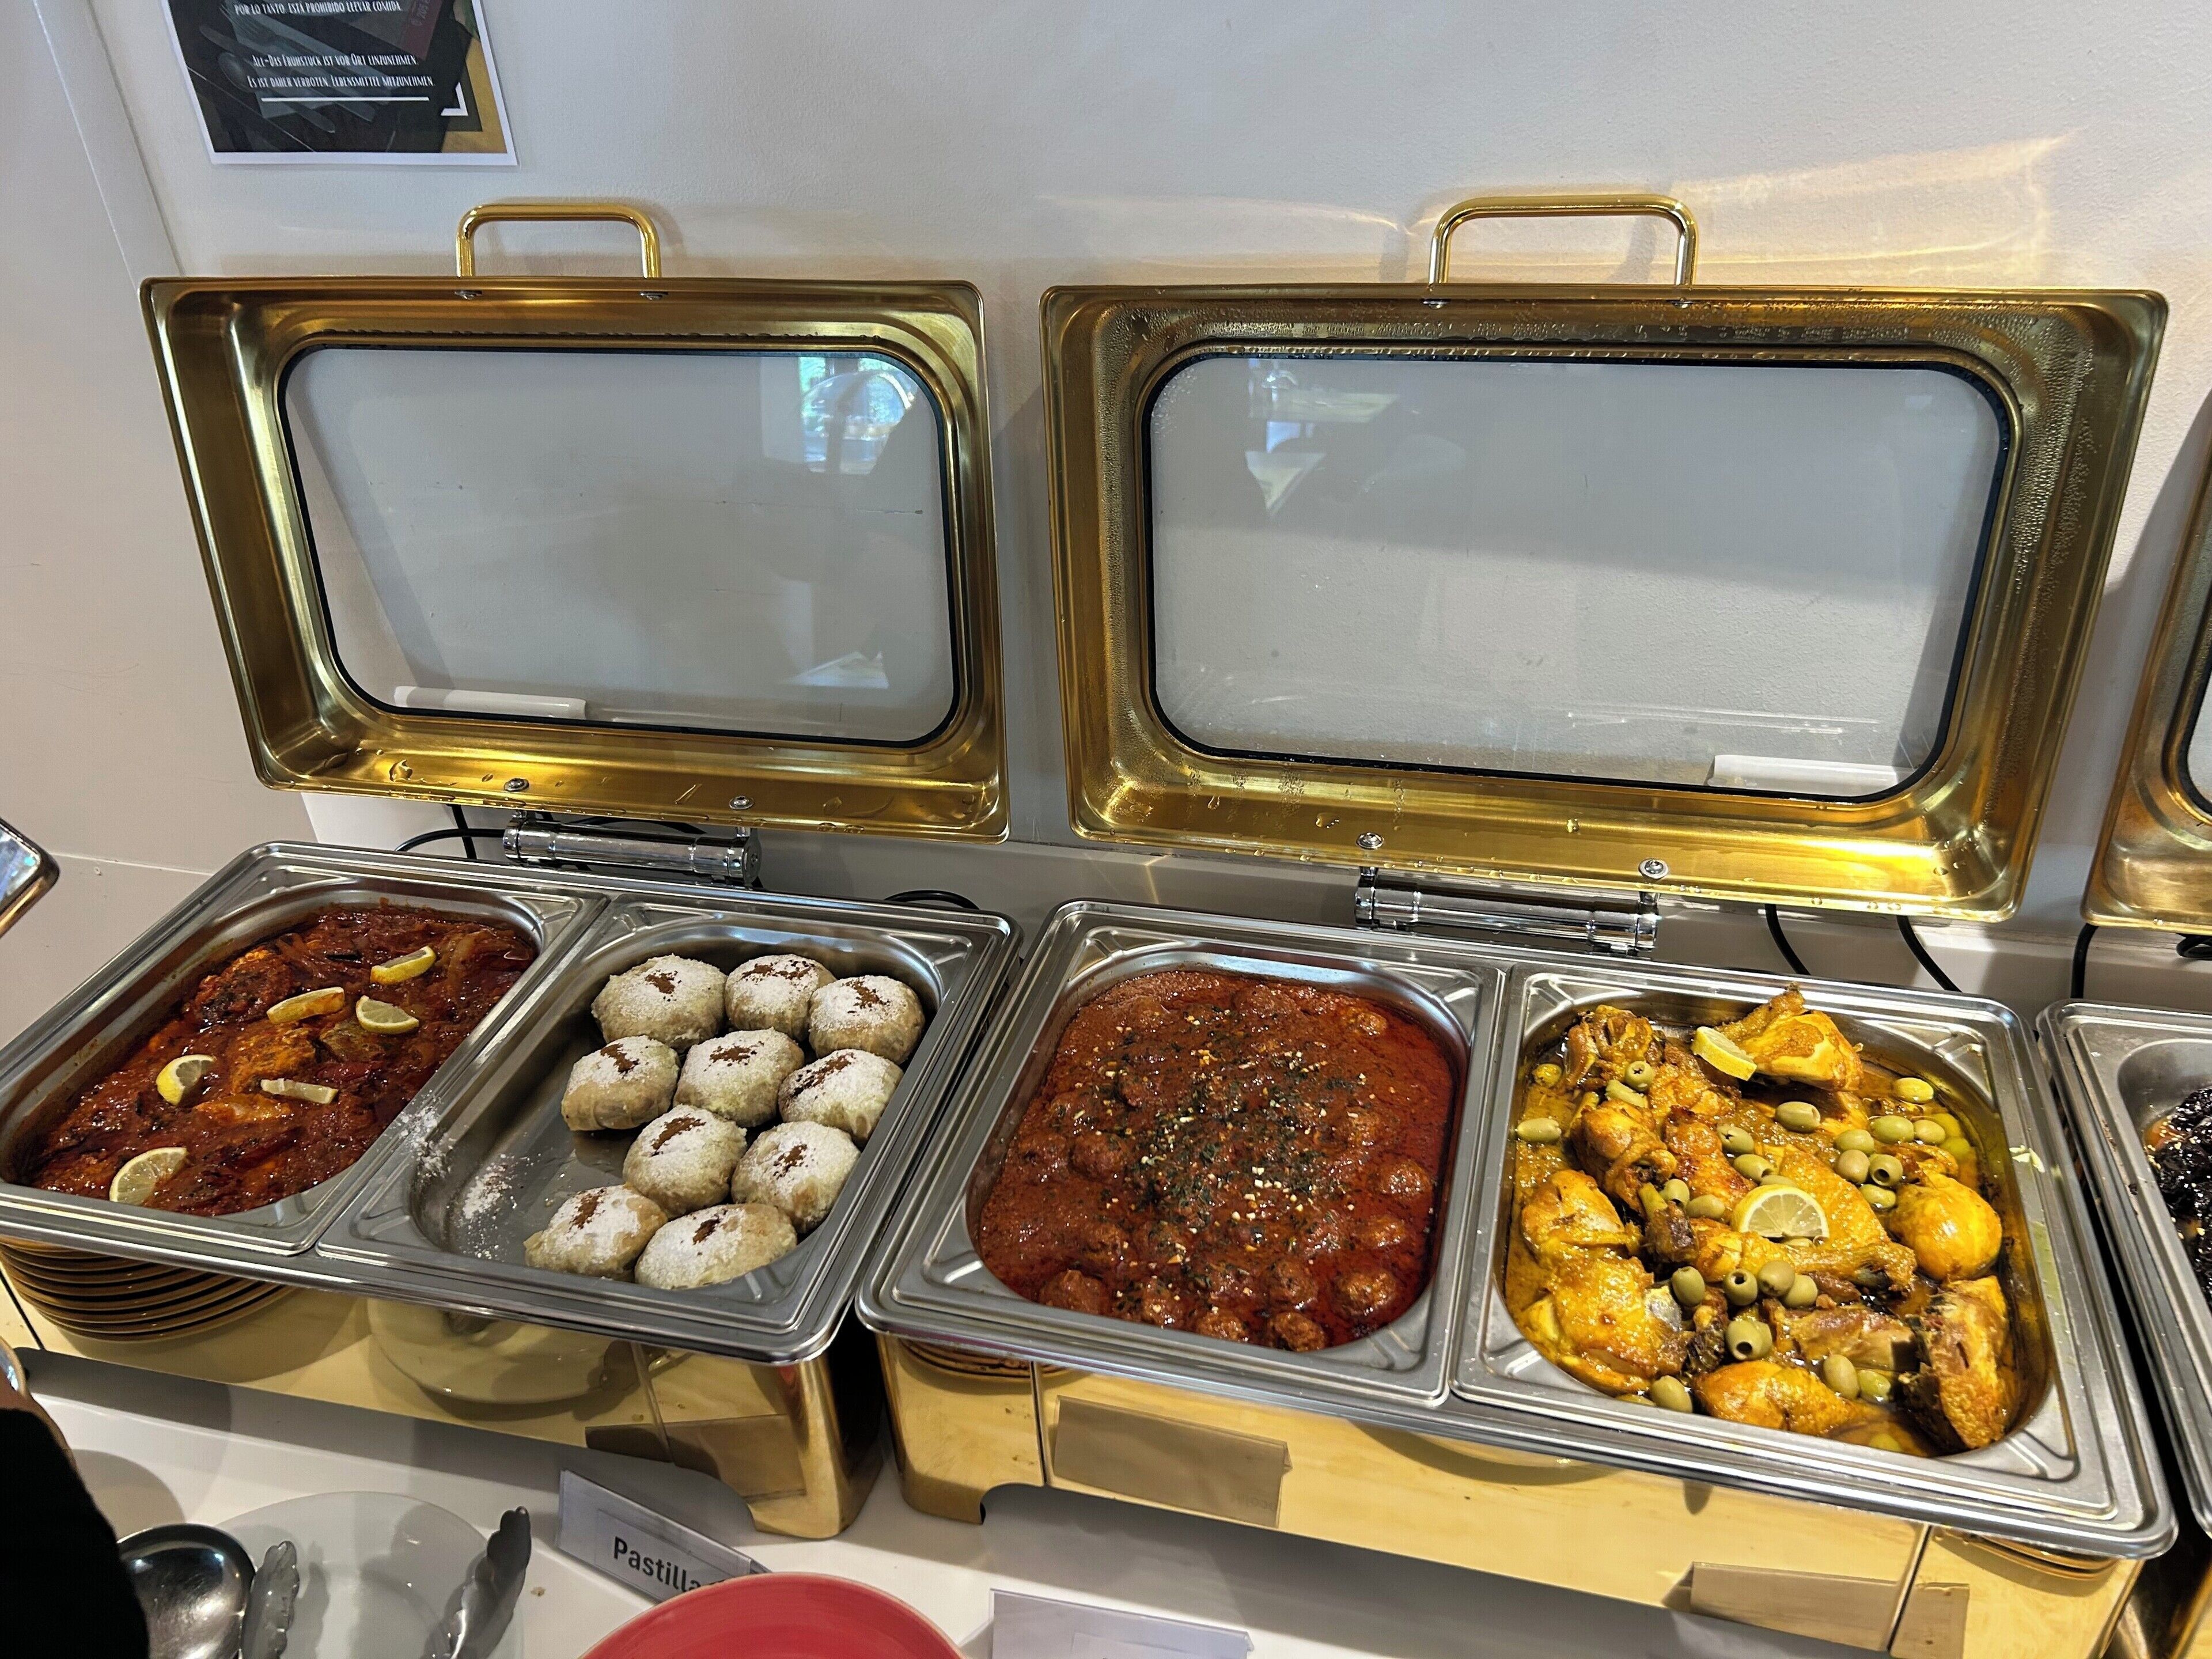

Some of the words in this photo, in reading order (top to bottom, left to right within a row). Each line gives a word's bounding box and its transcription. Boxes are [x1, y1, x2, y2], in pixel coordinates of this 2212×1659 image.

[234, 4, 250, 16] POR
[251, 3, 261, 15] LO
[305, 1, 345, 14] PROHIBIDO
[346, 1, 372, 13] LLEVAR
